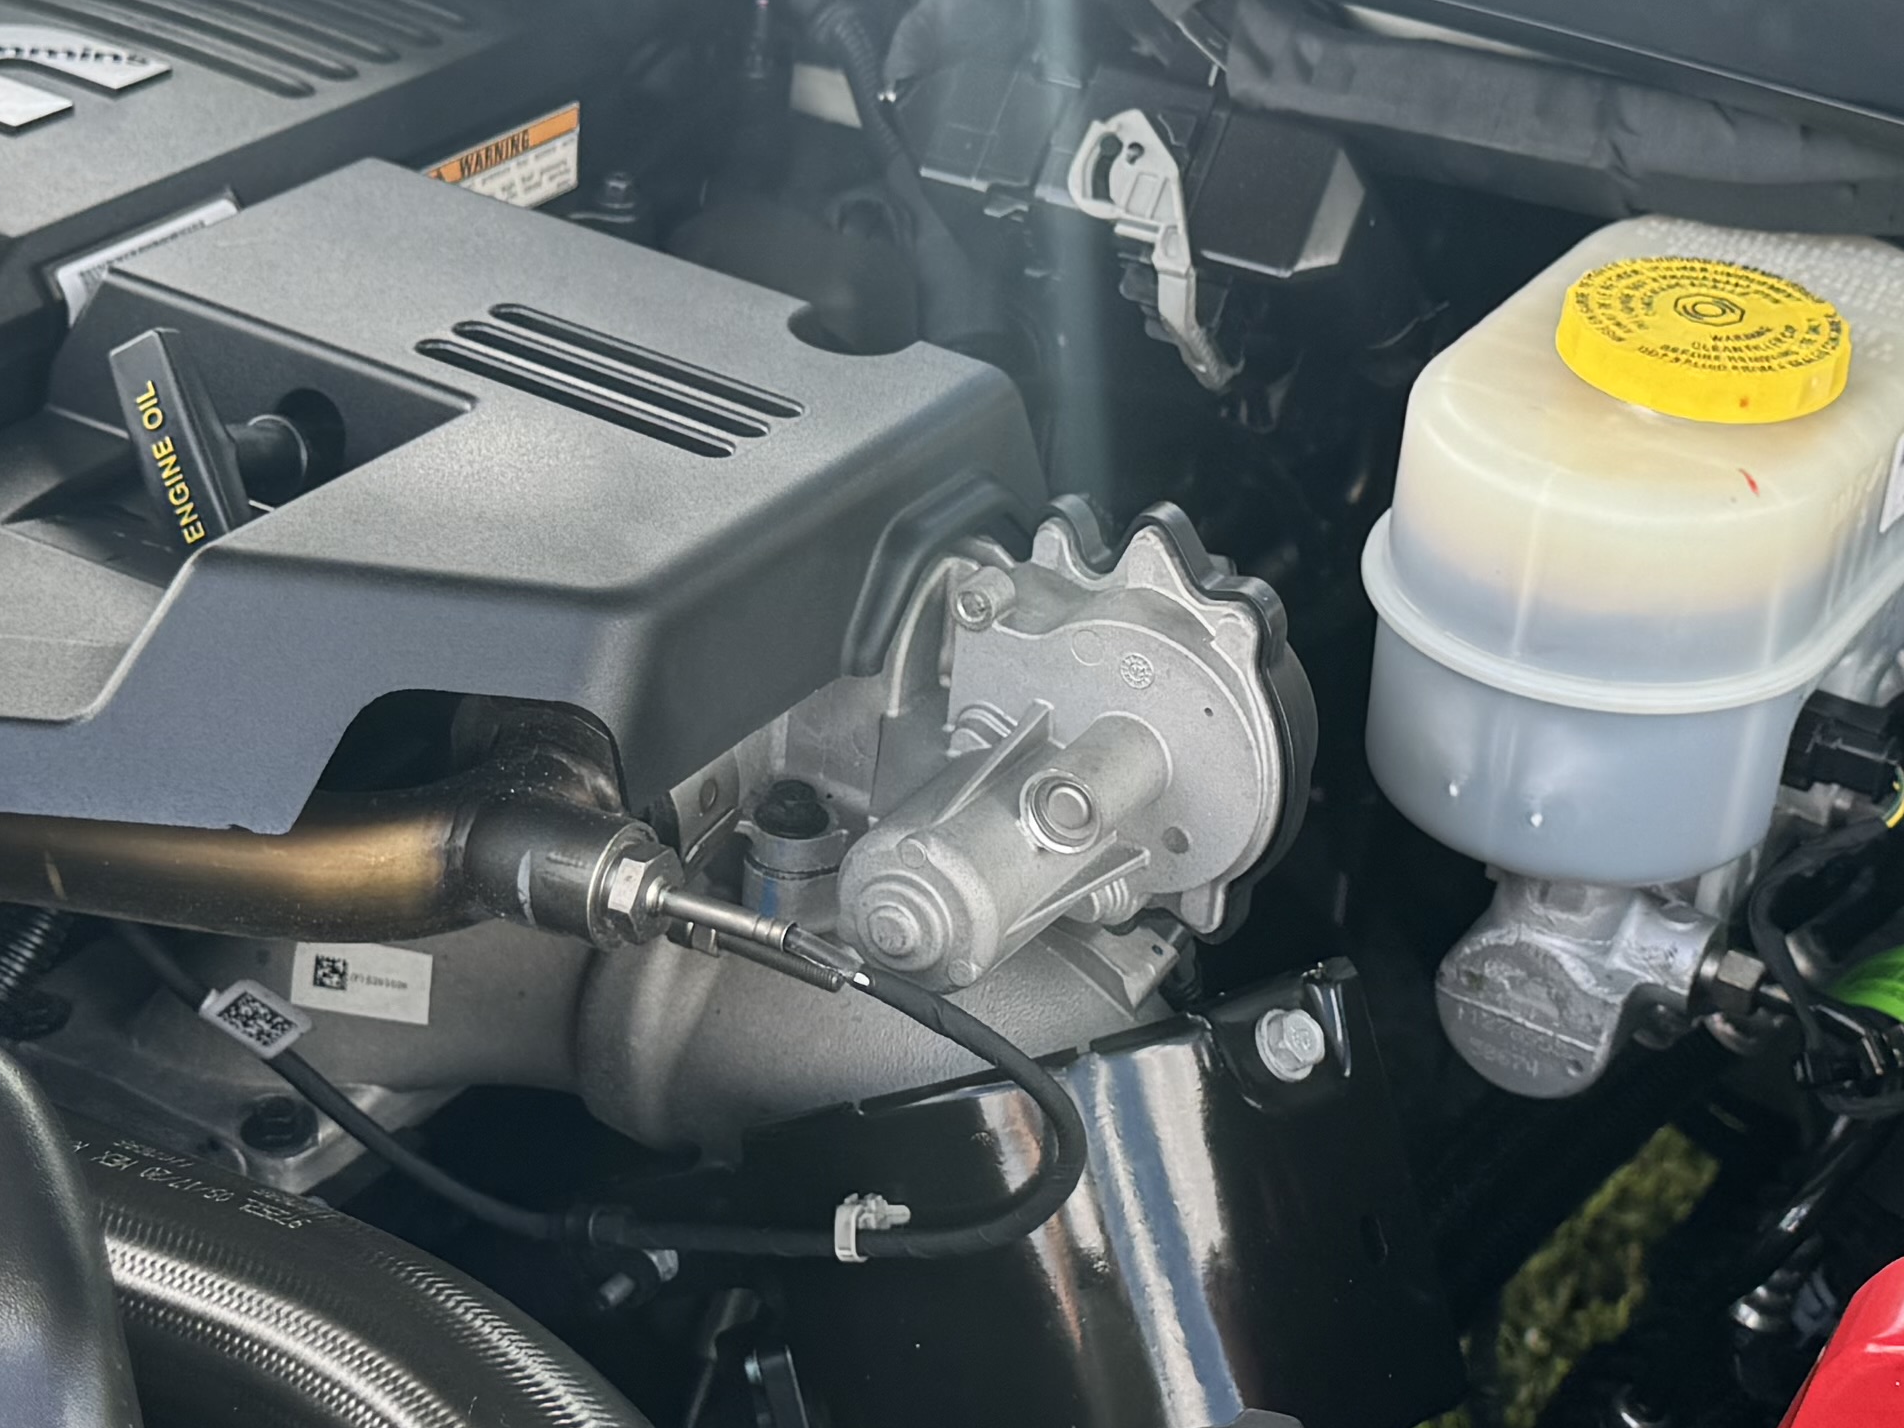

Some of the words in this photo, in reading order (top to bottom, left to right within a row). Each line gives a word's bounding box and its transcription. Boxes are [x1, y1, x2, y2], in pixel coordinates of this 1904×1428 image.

[459, 129, 531, 179] WARNING
[135, 379, 165, 432] OIL
[151, 435, 206, 545] ENGINE
